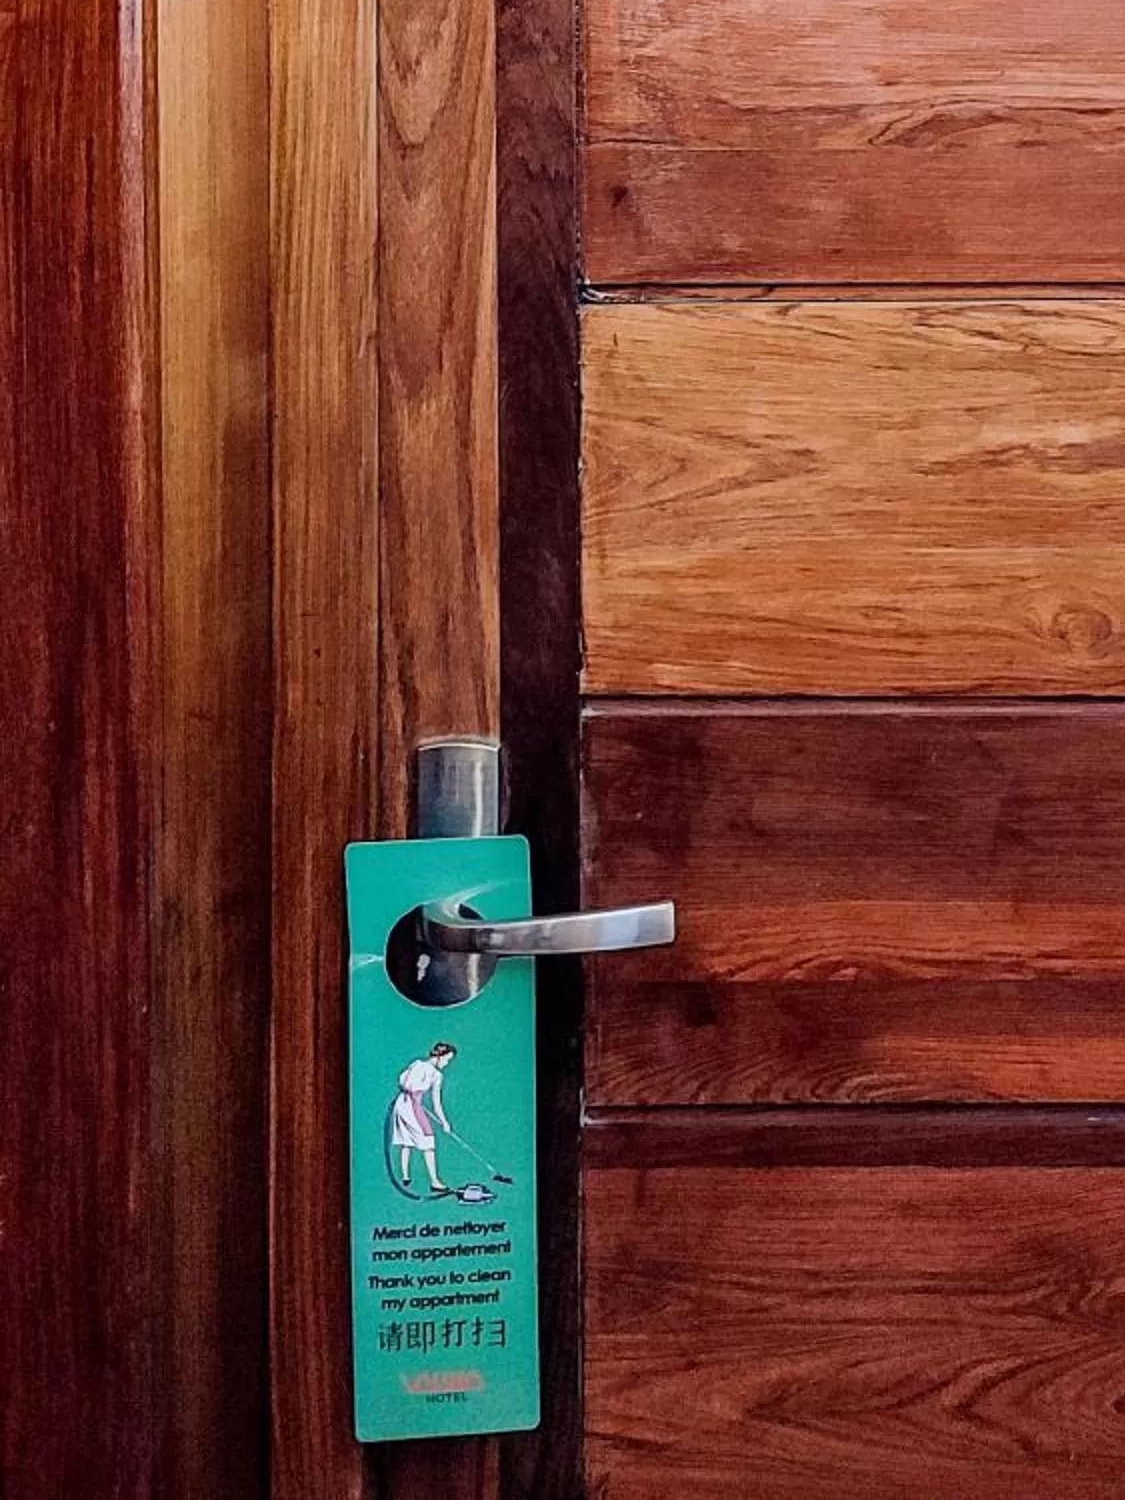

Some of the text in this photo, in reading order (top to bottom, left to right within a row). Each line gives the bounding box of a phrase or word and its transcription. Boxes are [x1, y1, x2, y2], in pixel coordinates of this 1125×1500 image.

[373, 1221, 506, 1240] Merci de nettoyer
[372, 1240, 512, 1262] mon appartement
[368, 1269, 512, 1290] Thank you to clean
[381, 1298, 407, 1313] my
[379, 1316, 506, 1354] 请即打扫
[426, 1391, 468, 1404] HOTEL
